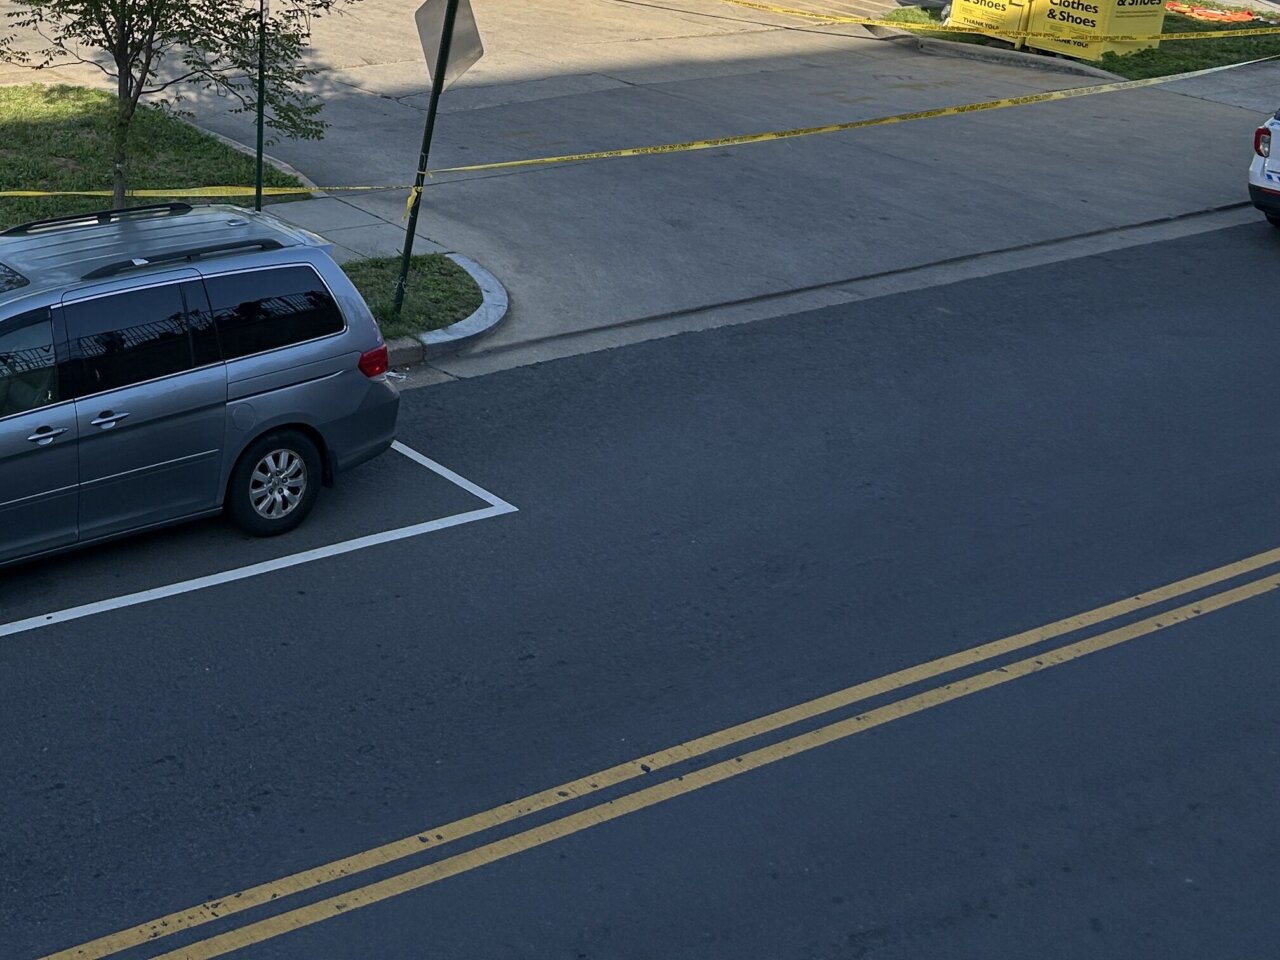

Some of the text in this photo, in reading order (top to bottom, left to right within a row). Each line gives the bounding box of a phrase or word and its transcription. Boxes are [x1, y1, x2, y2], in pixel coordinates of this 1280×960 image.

[963, 16, 984, 28] THANK
[1047, 8, 1096, 27] & Shoes
[1072, 40, 1088, 49] YOU!
